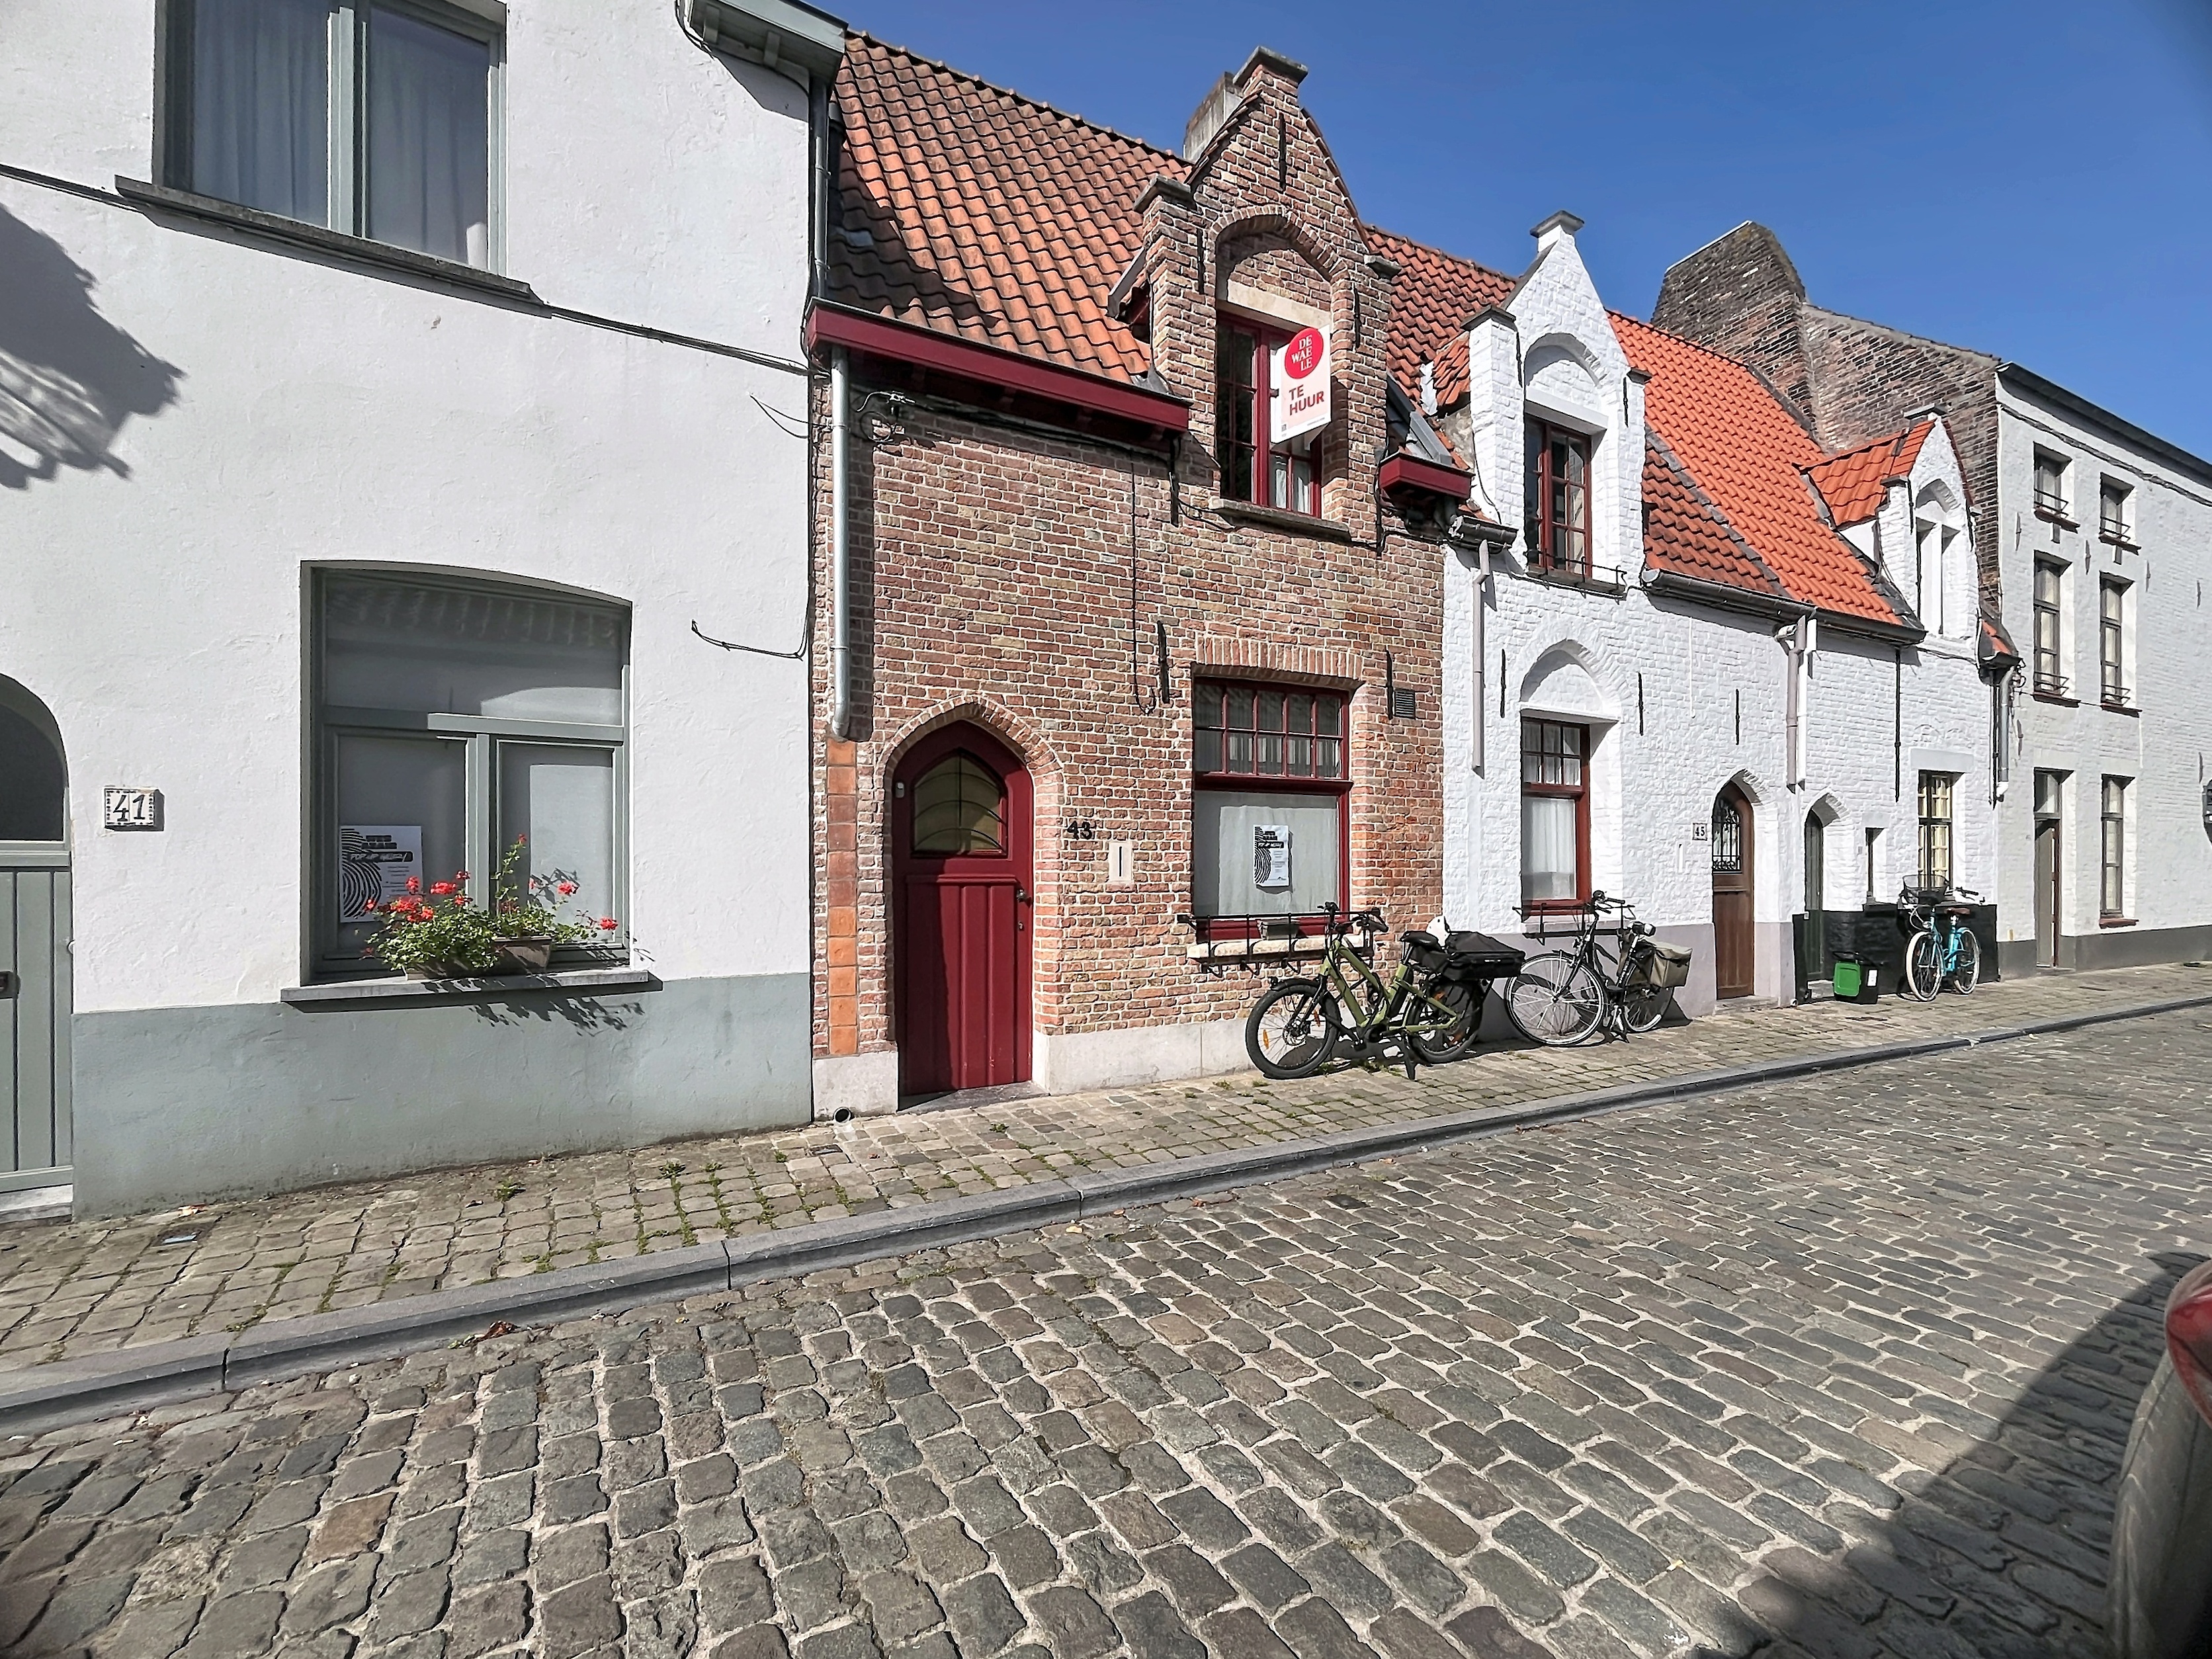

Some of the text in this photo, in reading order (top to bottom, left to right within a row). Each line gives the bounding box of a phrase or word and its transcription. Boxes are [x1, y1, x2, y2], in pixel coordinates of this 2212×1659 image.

[1298, 334, 1312, 351] DE
[1291, 345, 1312, 364] WAE
[1300, 357, 1312, 372] LE
[1289, 384, 1304, 401] TE
[1289, 390, 1325, 416] HUUR
[112, 794, 146, 822] 41
[1066, 820, 1093, 840] 43
[1695, 826, 1705, 837] 45
